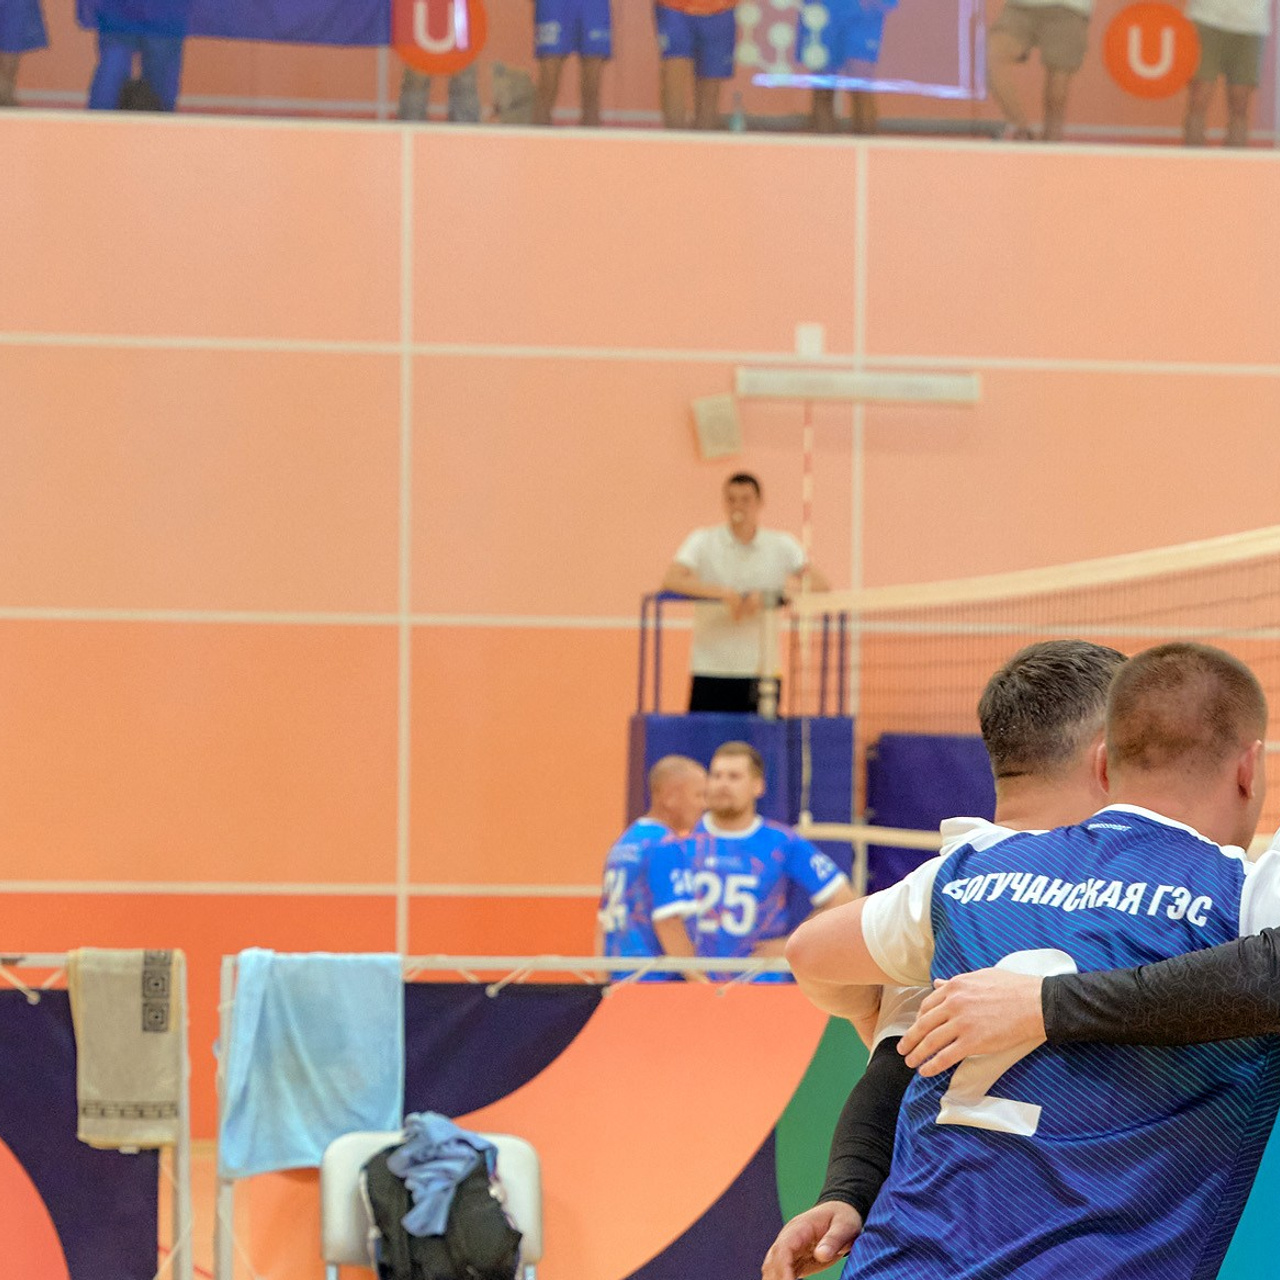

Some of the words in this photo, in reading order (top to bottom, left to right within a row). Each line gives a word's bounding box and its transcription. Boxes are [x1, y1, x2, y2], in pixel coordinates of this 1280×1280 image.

[1128, 24, 1174, 79] U
[694, 871, 758, 936] 25
[941, 871, 1147, 915] БОГУЧАНСКАЯ
[1147, 885, 1213, 927] ГЭС
[935, 948, 1078, 1137] 2
